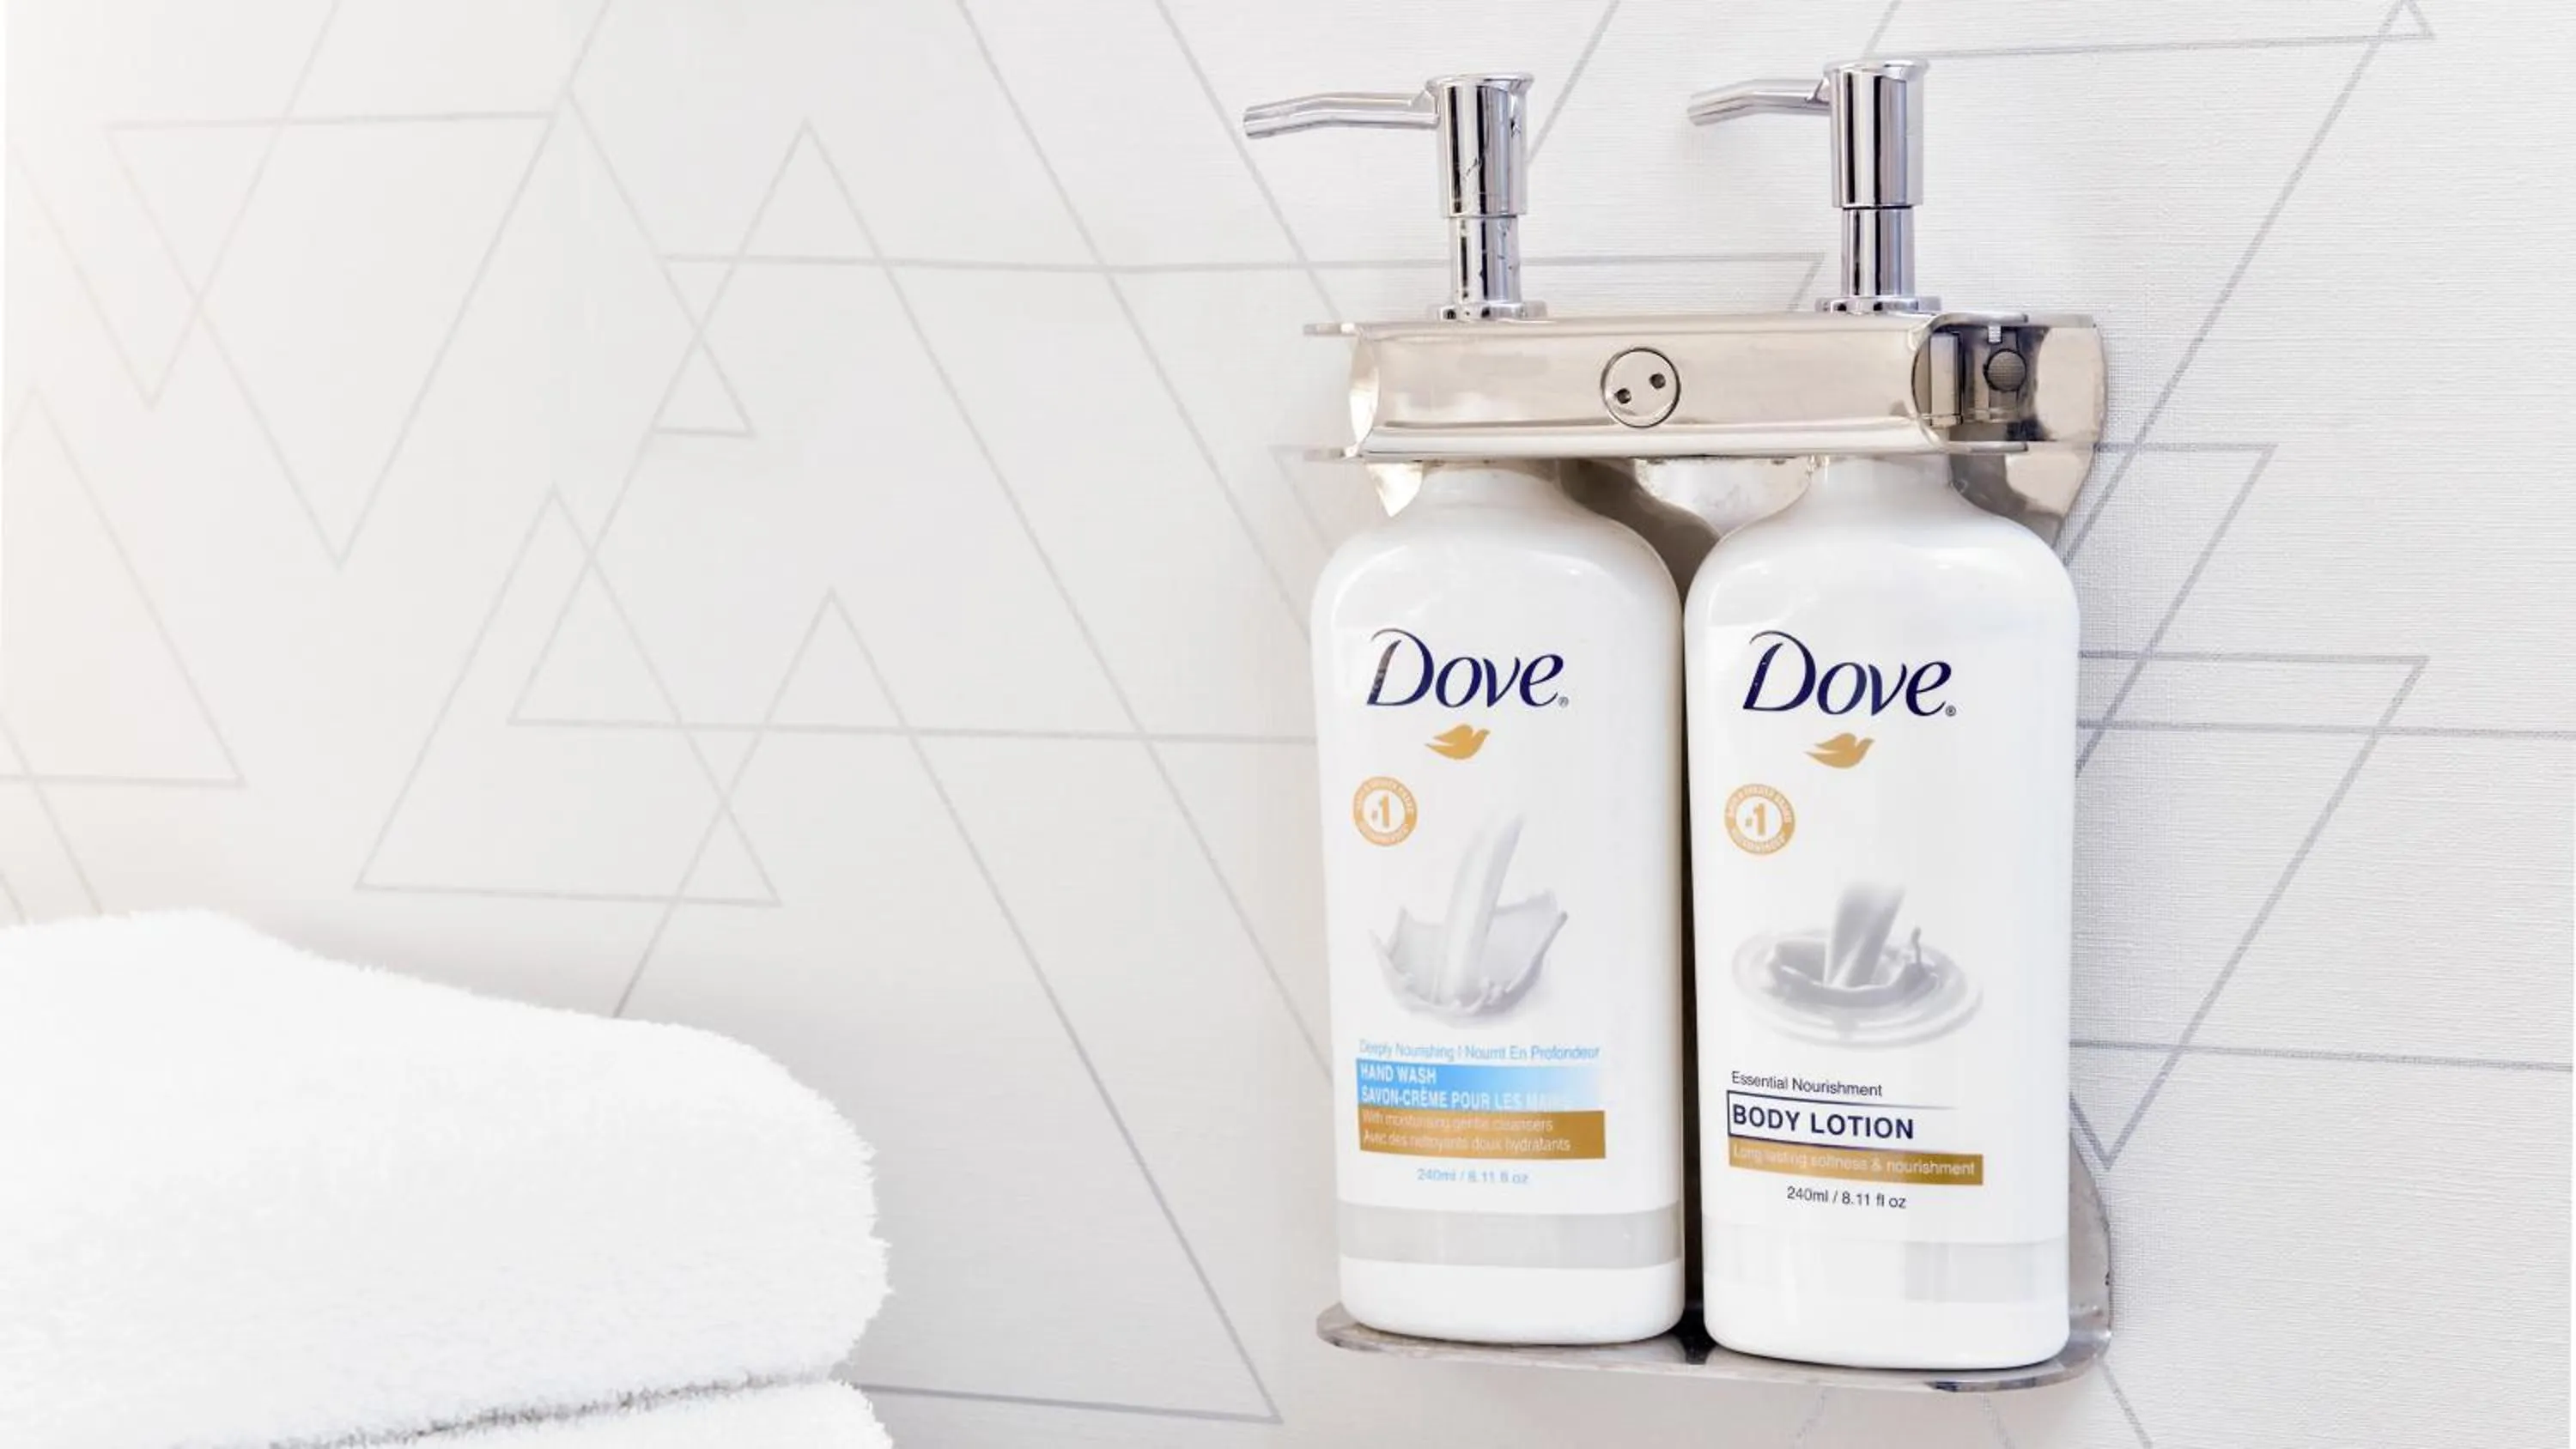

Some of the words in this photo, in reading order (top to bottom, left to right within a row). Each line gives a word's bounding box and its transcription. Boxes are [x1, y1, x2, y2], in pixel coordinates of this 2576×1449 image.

[1366, 627, 1564, 708] Dove
[1742, 630, 1953, 716] Dove
[1510, 1045, 1527, 1059] En
[1360, 1063, 1394, 1082] HAND
[1397, 1065, 1437, 1085] WASH
[1732, 1070, 1789, 1090] Essential
[1792, 1077, 1883, 1098] Nourishment
[1452, 1091, 1490, 1109] POUR
[1495, 1092, 1522, 1109] LES
[1733, 1104, 1801, 1131] BODY
[1811, 1113, 1914, 1139] LOTION
[1416, 1167, 1456, 1182] 240ml
[1512, 1173, 1528, 1185] oz
[1870, 1157, 1881, 1173] &
[1886, 1159, 1975, 1176] nourishment
[1787, 1185, 1829, 1203] 240ml
[1842, 1190, 1869, 1206] 8.11
[1888, 1197, 1906, 1209] oz
